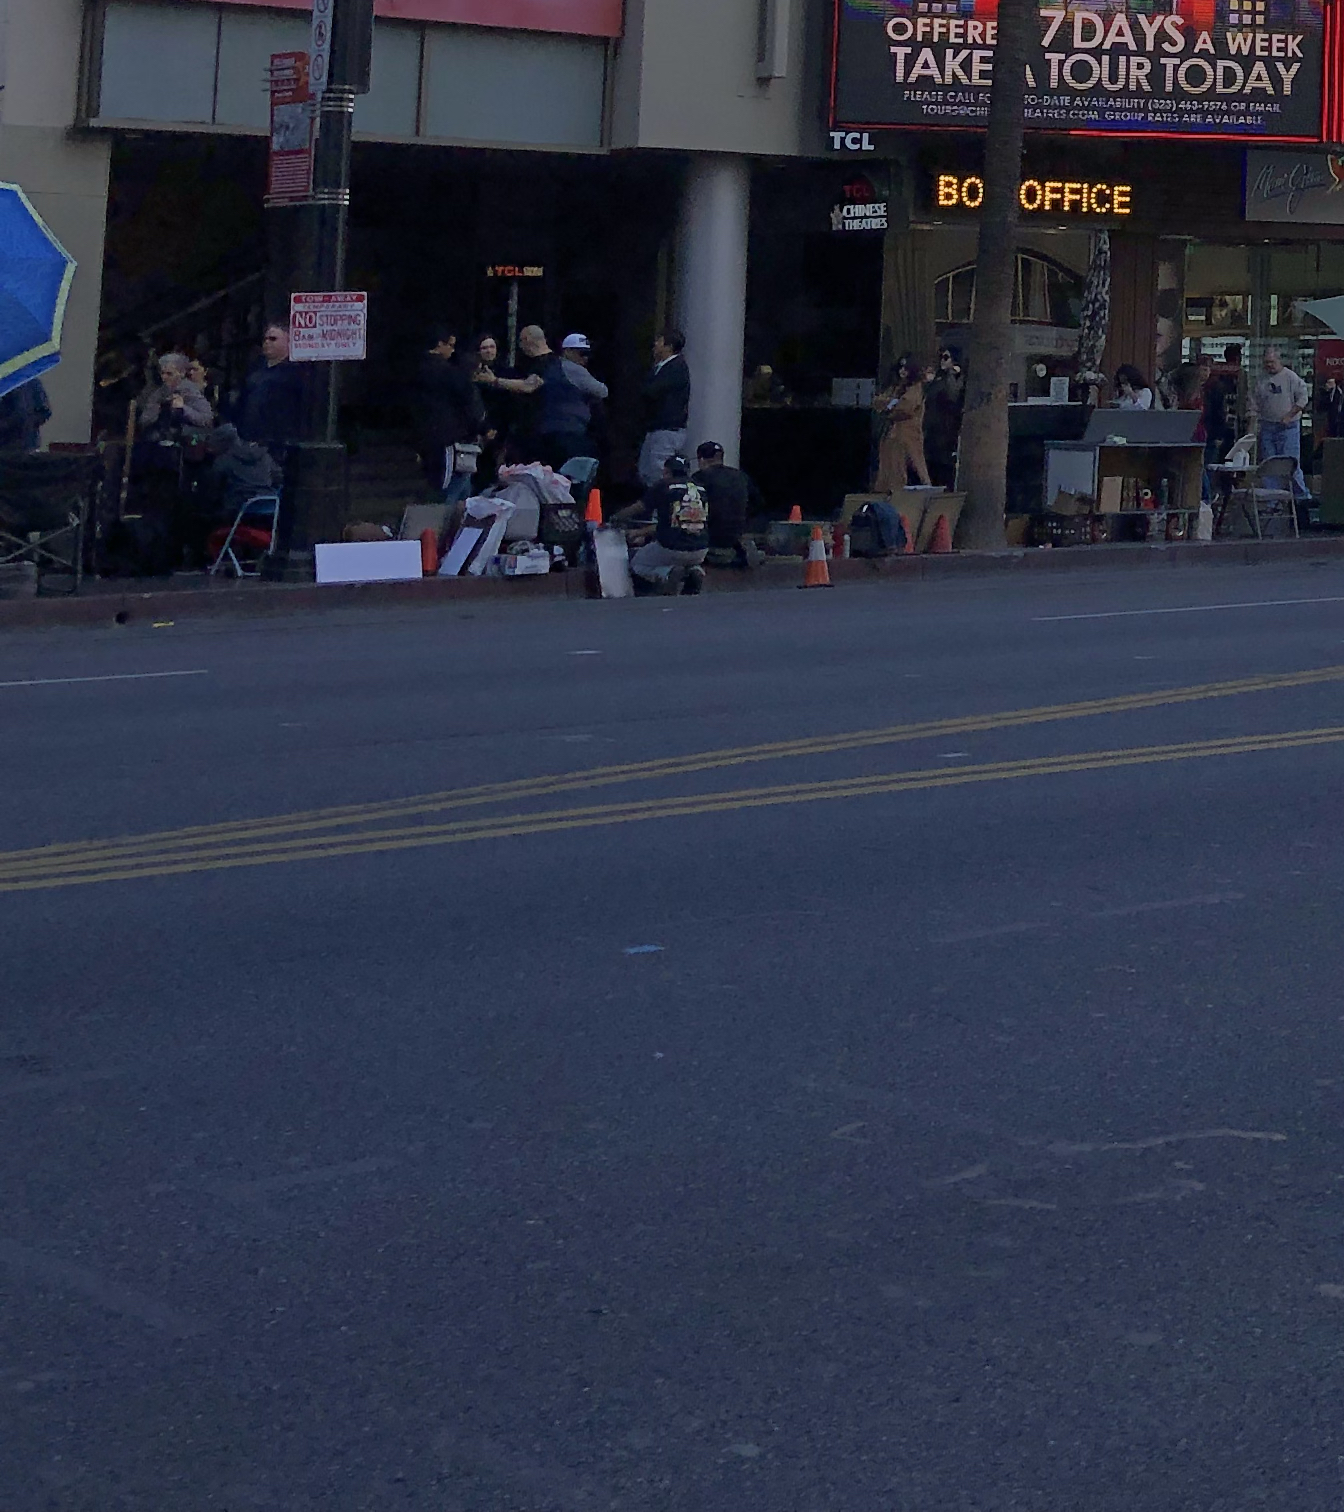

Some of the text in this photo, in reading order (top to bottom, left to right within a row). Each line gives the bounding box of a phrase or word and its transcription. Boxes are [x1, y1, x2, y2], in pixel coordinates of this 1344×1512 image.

[886, 9, 1304, 58] OFFERE 7 DAYS A WEEK
[890, 46, 994, 86] TAKE
[1045, 52, 1153, 92] TOUR
[1159, 56, 1301, 96] TODAY
[904, 90, 943, 103] PLEASE
[946, 91, 976, 104] CALL
[1074, 96, 1145, 110] AVAILABILITY
[1230, 101, 1245, 111] OR
[1249, 102, 1282, 113] EMAIL
[1105, 110, 1144, 121] GROUP
[1147, 112, 1179, 123] RATES
[1182, 113, 1202, 124] ARE
[829, 131, 875, 151] TCL
[938, 174, 1132, 214] BO OFFICE
[842, 202, 888, 218] CHINESE
[843, 217, 888, 231] THEATRES
[301, 294, 358, 303] TOW-AWAY
[295, 312, 361, 328] NO STOPPING
